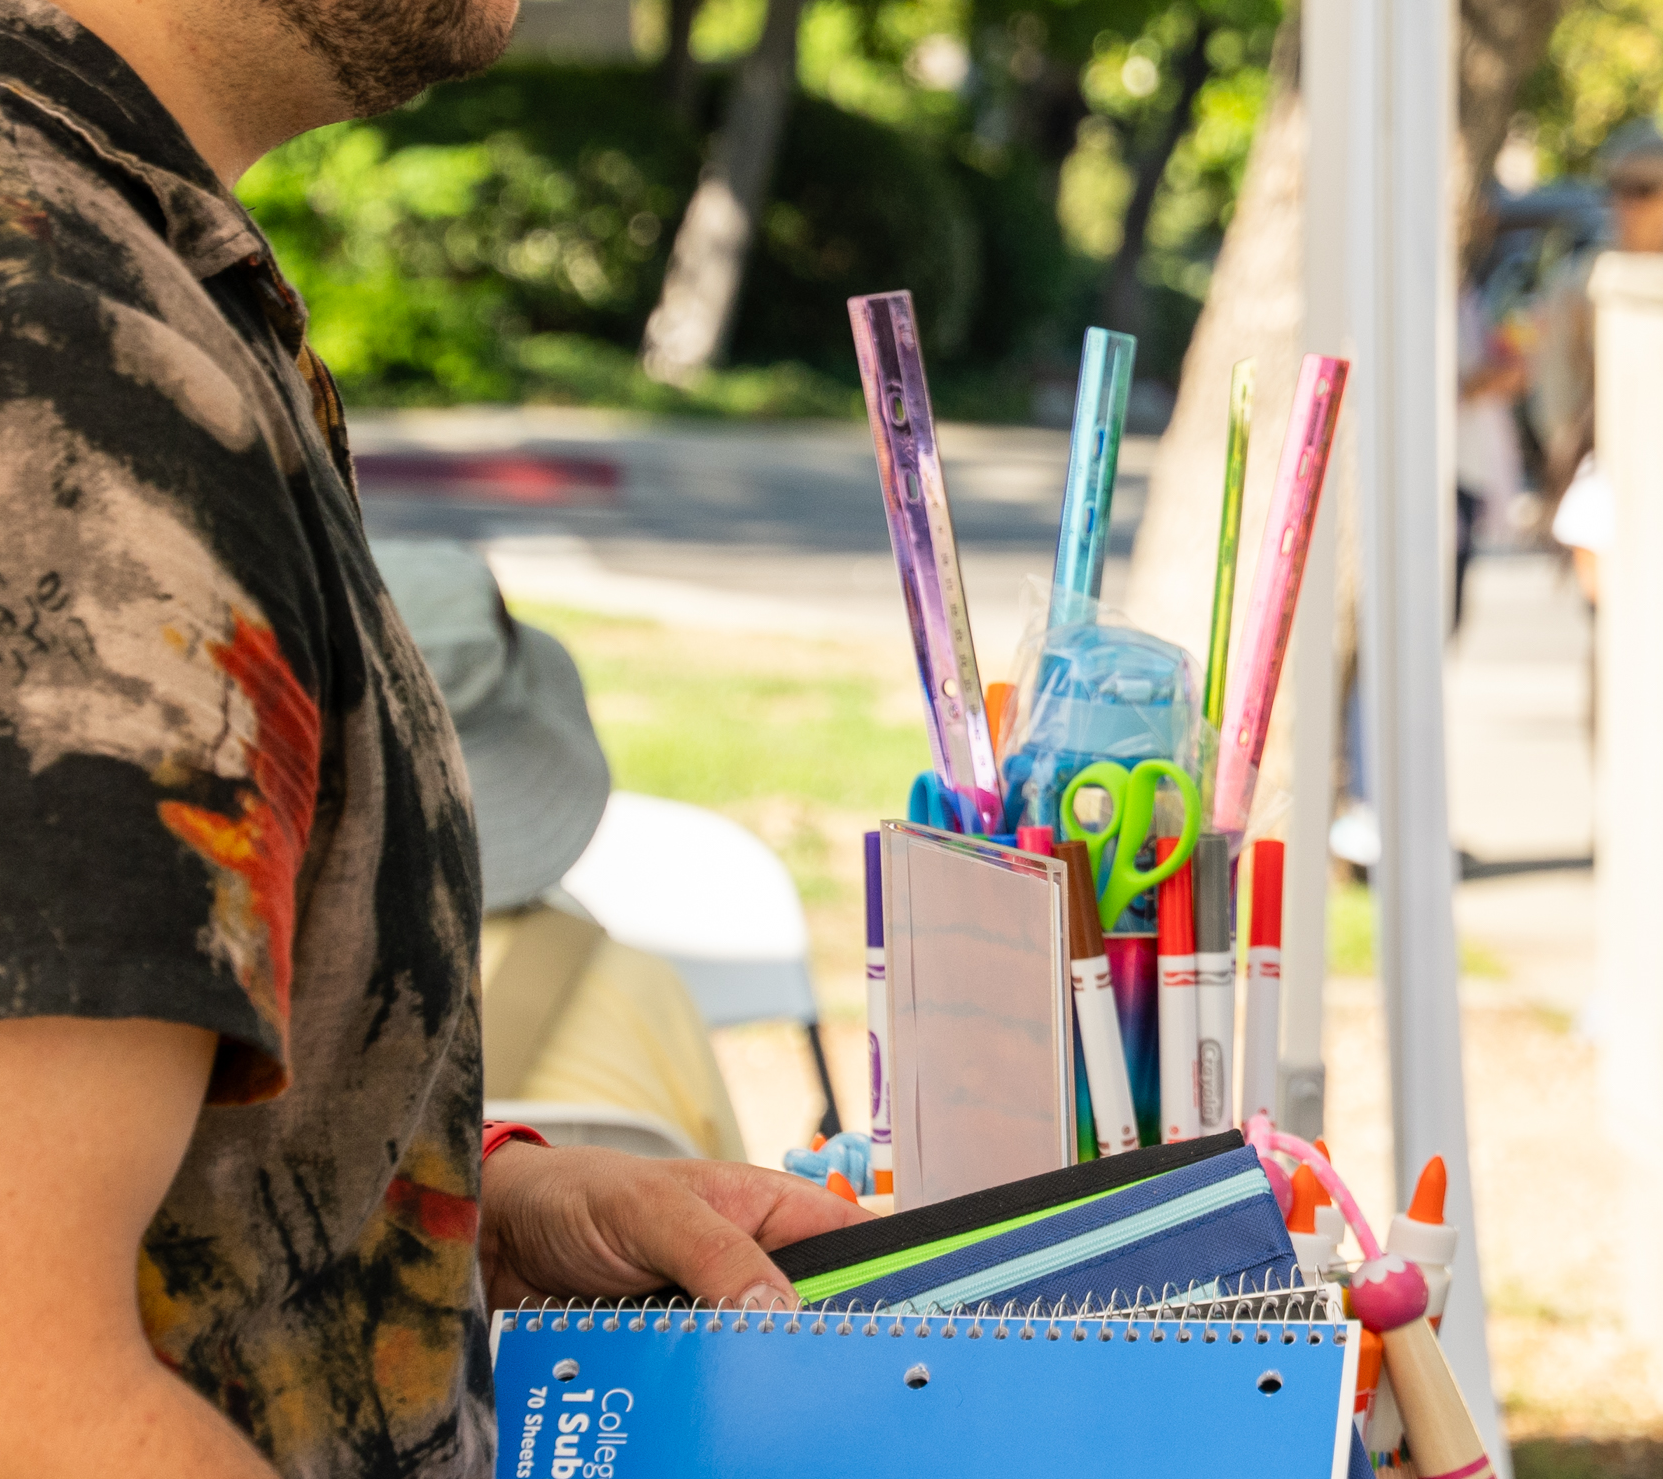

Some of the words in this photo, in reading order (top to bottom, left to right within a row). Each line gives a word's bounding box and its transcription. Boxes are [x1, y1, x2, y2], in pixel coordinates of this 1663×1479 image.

[1201, 1044, 1218, 1119] Crayola
[526, 1386, 548, 1410] 70
[561, 1388, 594, 1403] 1
[516, 1412, 544, 1479] Sheets
